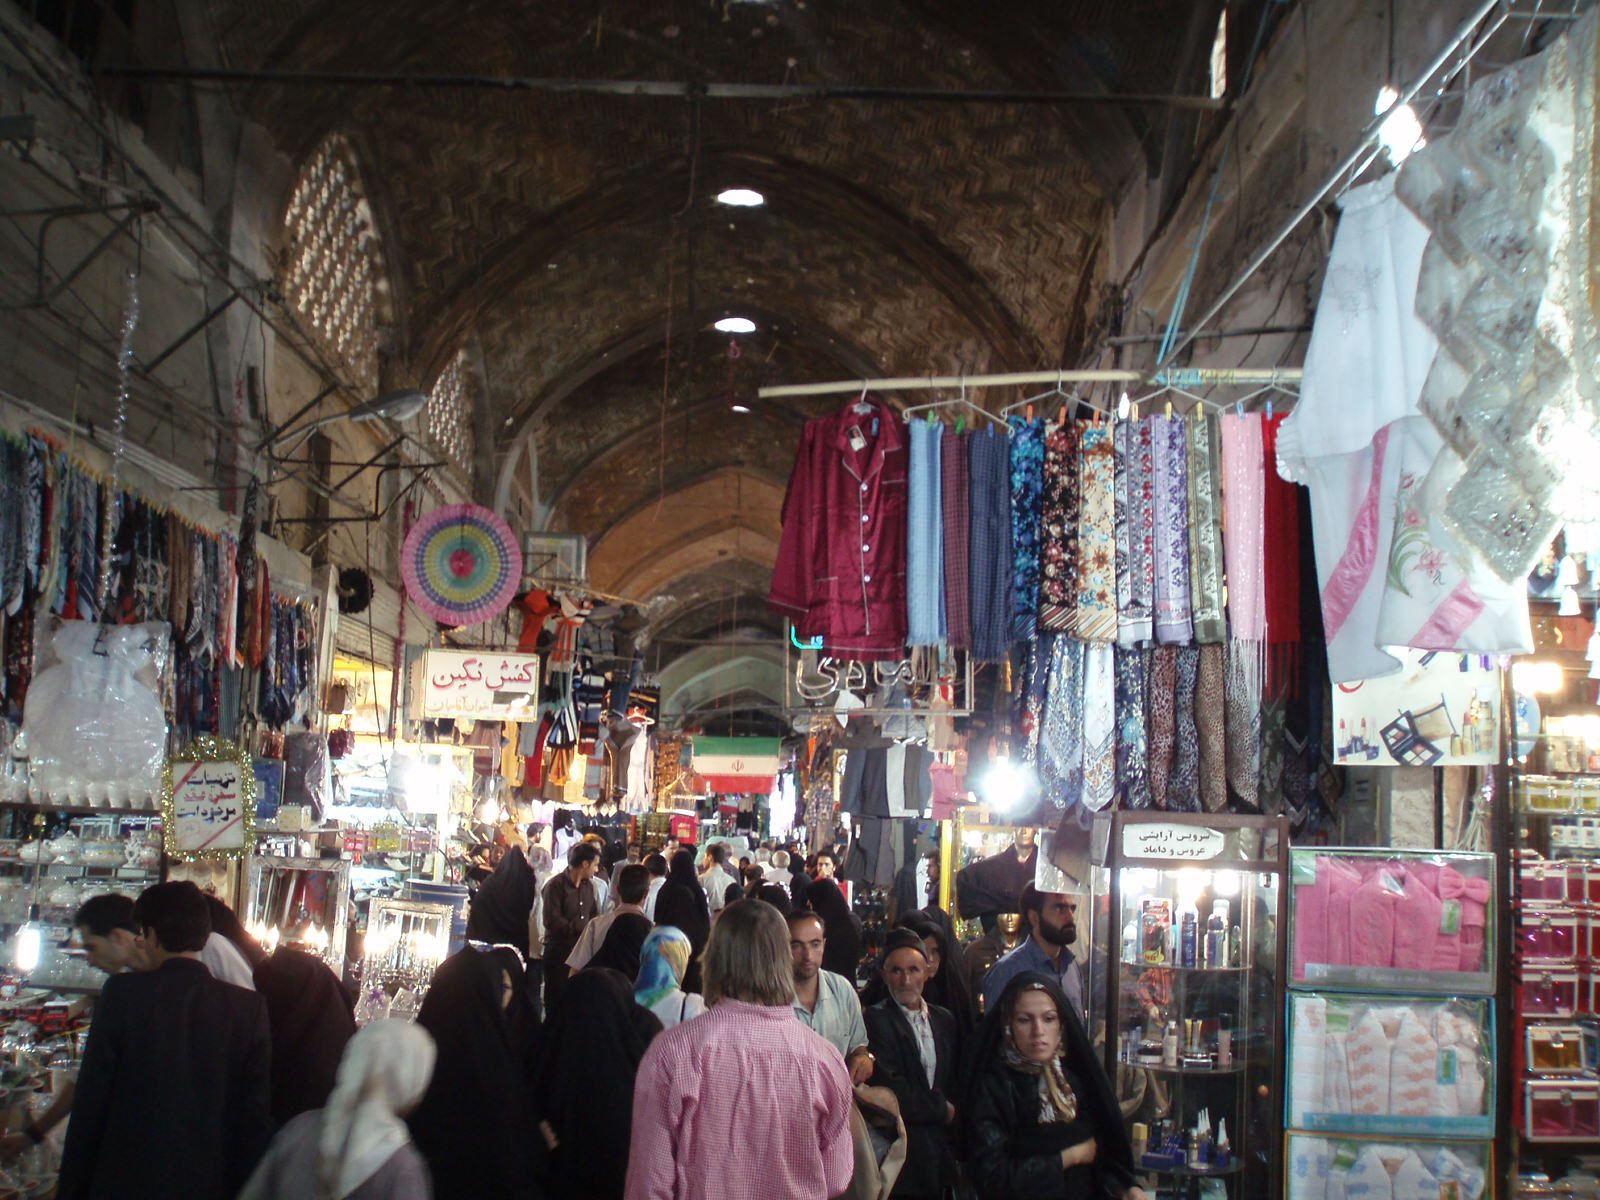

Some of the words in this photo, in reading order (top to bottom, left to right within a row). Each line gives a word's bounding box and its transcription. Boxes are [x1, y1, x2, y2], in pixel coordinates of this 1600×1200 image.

[432, 658, 483, 689] نگین
[485, 660, 536, 689] کفش
[177, 805, 200, 818] است
[201, 806, 236, 823] موجود
[1138, 830, 1173, 842] آرایشی
[1176, 831, 1210, 842] سرویس
[1143, 845, 1167, 854] داماد
[1169, 848, 1175, 856] و
[1176, 846, 1206, 856] عروس
